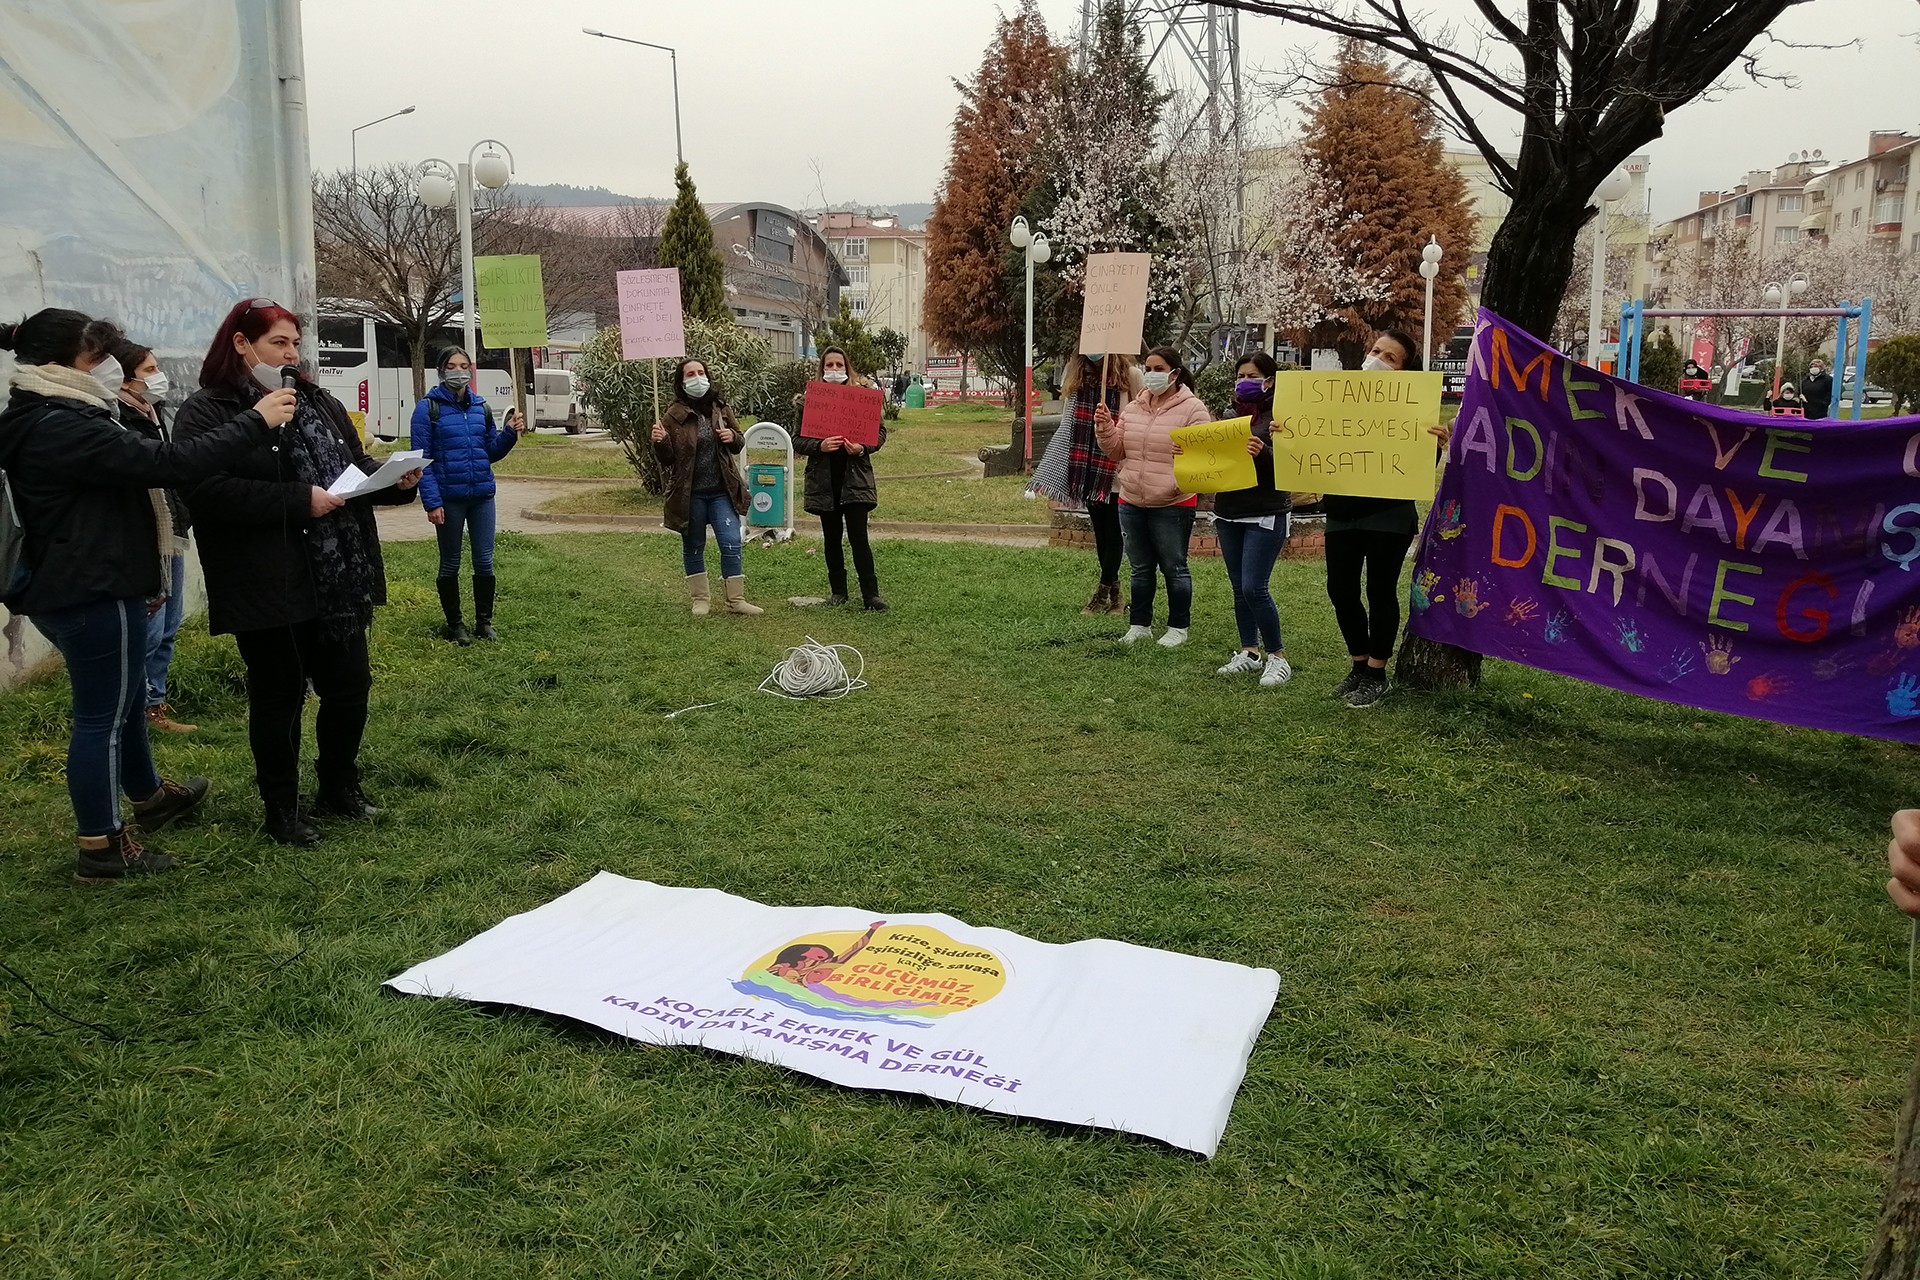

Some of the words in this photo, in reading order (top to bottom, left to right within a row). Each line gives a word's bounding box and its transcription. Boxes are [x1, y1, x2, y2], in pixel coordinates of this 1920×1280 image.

[626, 286, 670, 299] DOKUNMA
[625, 314, 646, 325] DUR
[1443, 362, 1456, 370] CAR
[1300, 377, 1419, 404] İSTANBUL
[1283, 414, 1419, 442] SÖZLEŞMESİ
[1206, 448, 1217, 466] 8
[1290, 450, 1405, 475] YAŞATIR
[1692, 415, 1815, 484] VE
[1189, 470, 1224, 483] MART
[888, 932, 932, 951] Krize,
[932, 945, 994, 962] şiddete,
[865, 944, 945, 970] eşitsizliğe,
[946, 962, 1000, 978] savaşa
[896, 957, 928, 972] karşı
[851, 962, 975, 993] GÜCÜMÜZ
[601, 994, 696, 1031] KADIN
[697, 1018, 871, 1065] DAYANIŞMA
[877, 1056, 1024, 1095] DERNEĞİ
[653, 995, 778, 1022] KOCAELİ
[778, 1018, 879, 1046] EKMEK
[885, 1037, 930, 1059] VE
[930, 1046, 991, 1070] GÜL
